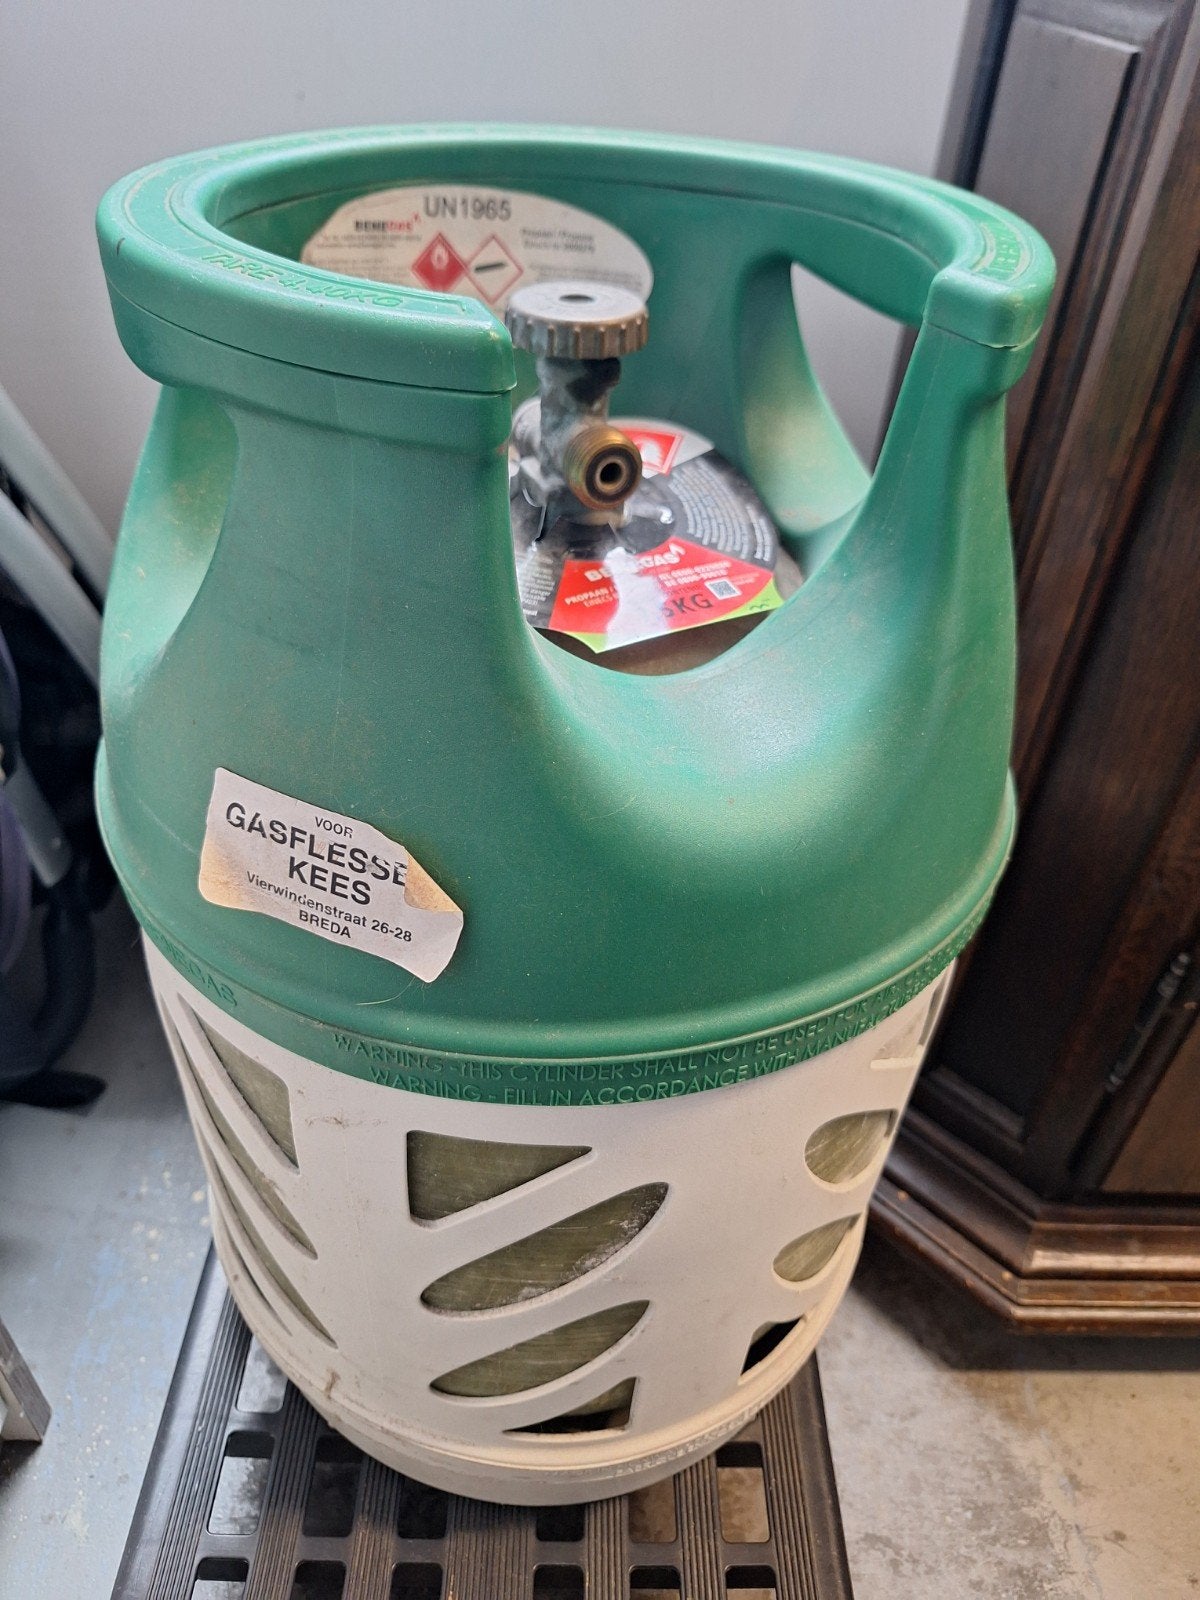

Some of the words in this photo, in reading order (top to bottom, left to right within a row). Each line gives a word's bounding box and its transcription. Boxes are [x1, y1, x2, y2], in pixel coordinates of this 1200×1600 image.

[423, 195, 513, 221] UN1965
[201, 251, 284, 281] TARE
[314, 815, 354, 839] VOOR
[288, 856, 372, 906] KEES
[246, 870, 367, 928] Vierwindenstraat
[370, 918, 413, 942] 26-28
[298, 908, 352, 939] BREDA
[333, 1033, 445, 1073] WARNING
[510, 1064, 625, 1082] CYLINDER
[630, 1050, 698, 1079] SHALL
[704, 1043, 748, 1067] NOT
[755, 1037, 778, 1054] BE
[783, 1018, 831, 1046] USED
[369, 1066, 482, 1101] WARNING
[504, 1087, 543, 1106] FILL
[549, 1089, 572, 1106] IN
[579, 1063, 750, 1106] ACCORDANCE
[753, 1047, 800, 1078] WITH
